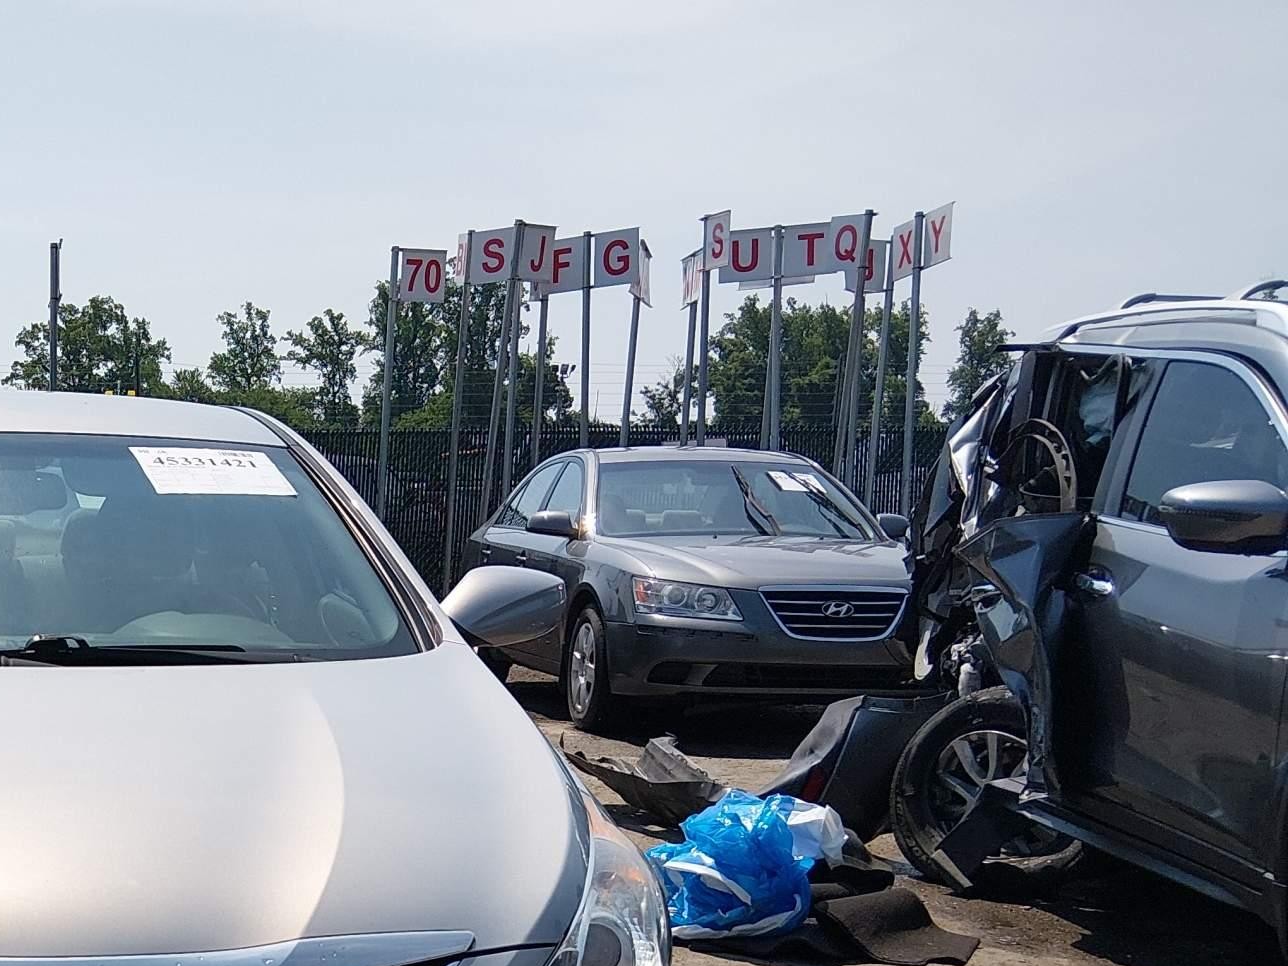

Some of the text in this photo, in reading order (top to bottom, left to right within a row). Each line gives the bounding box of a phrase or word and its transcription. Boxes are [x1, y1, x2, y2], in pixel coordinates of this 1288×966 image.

[711, 222, 724, 259] S
[798, 232, 825, 267] T
[834, 224, 858, 262] Q
[898, 230, 913, 269] X
[931, 215, 946, 254] Y
[482, 238, 505, 274] S
[530, 236, 546, 273] J
[552, 247, 573, 284] F
[602, 239, 630, 276] G
[731, 238, 759, 273] U
[406, 257, 442, 294] 70
[152, 455, 258, 469] 45331421
